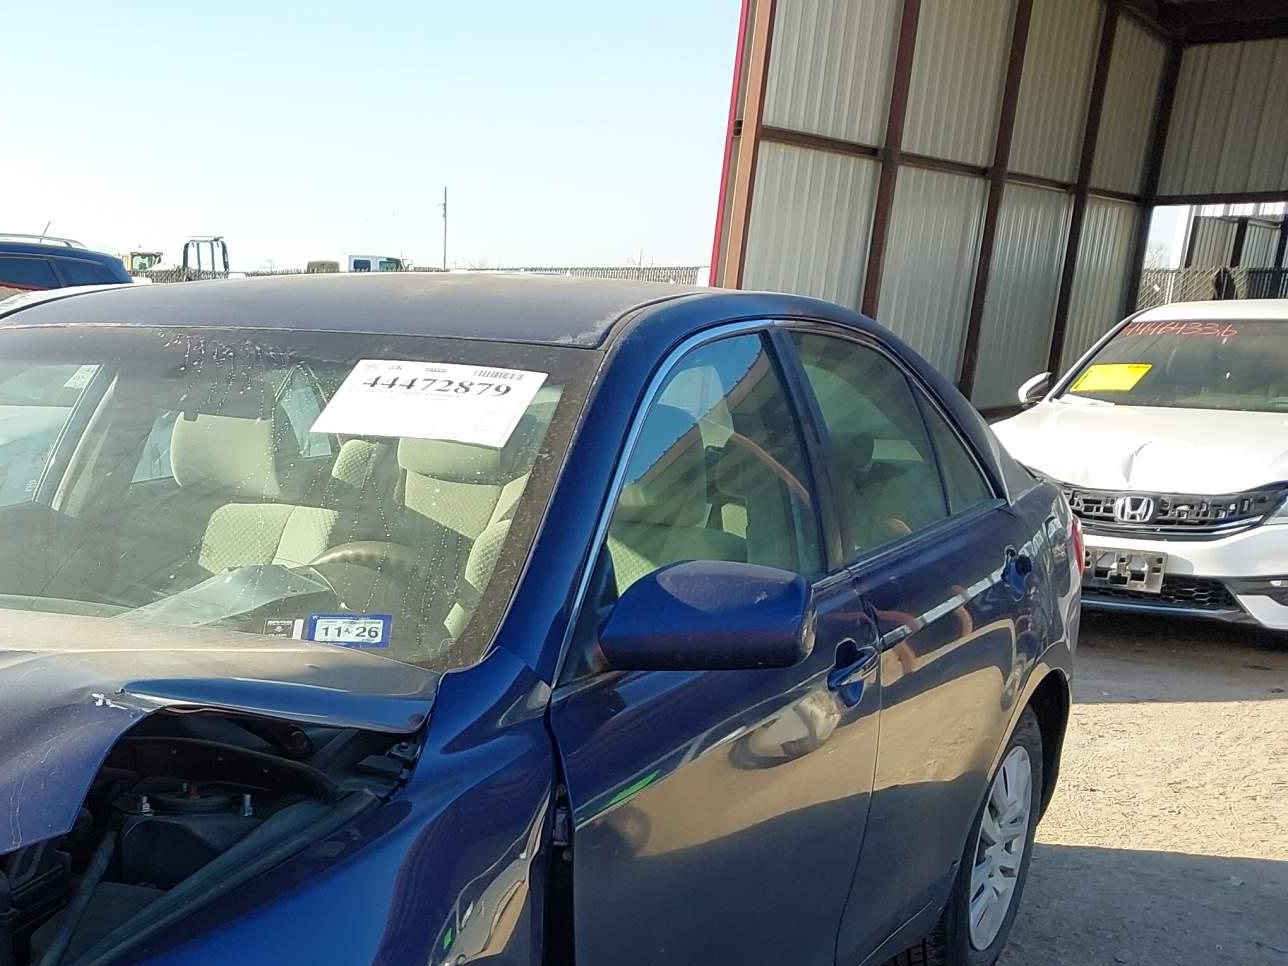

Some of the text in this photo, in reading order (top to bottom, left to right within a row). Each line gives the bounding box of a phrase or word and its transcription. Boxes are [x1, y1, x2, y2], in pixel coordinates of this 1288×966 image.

[362, 375, 513, 398] 44472879
[321, 626, 380, 639] 11 26
